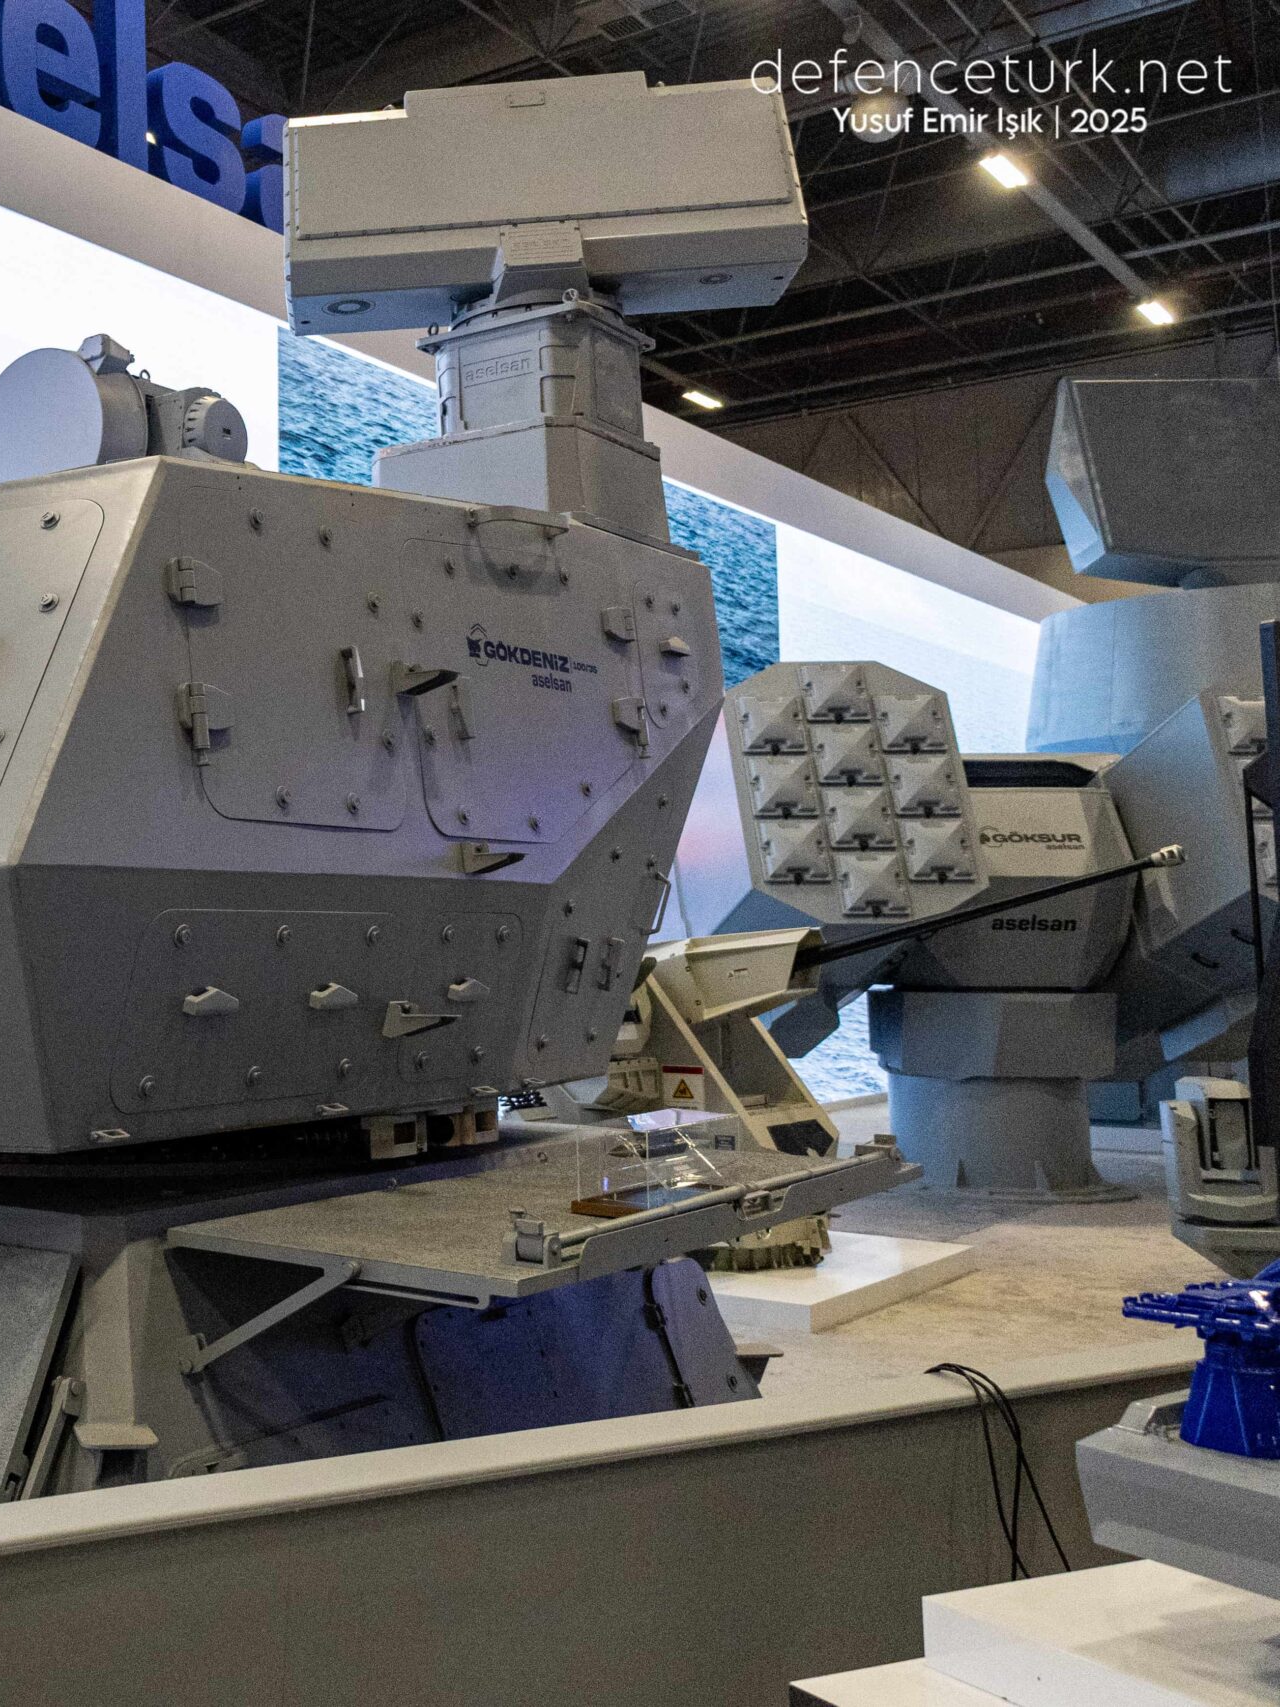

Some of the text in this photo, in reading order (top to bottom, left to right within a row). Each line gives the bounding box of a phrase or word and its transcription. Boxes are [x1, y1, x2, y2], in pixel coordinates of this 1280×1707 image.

[465, 357, 530, 381] aselsan
[531, 672, 572, 693] aselsan
[991, 831, 1082, 843] GÖKSUR
[991, 913, 1078, 932] aselsan
